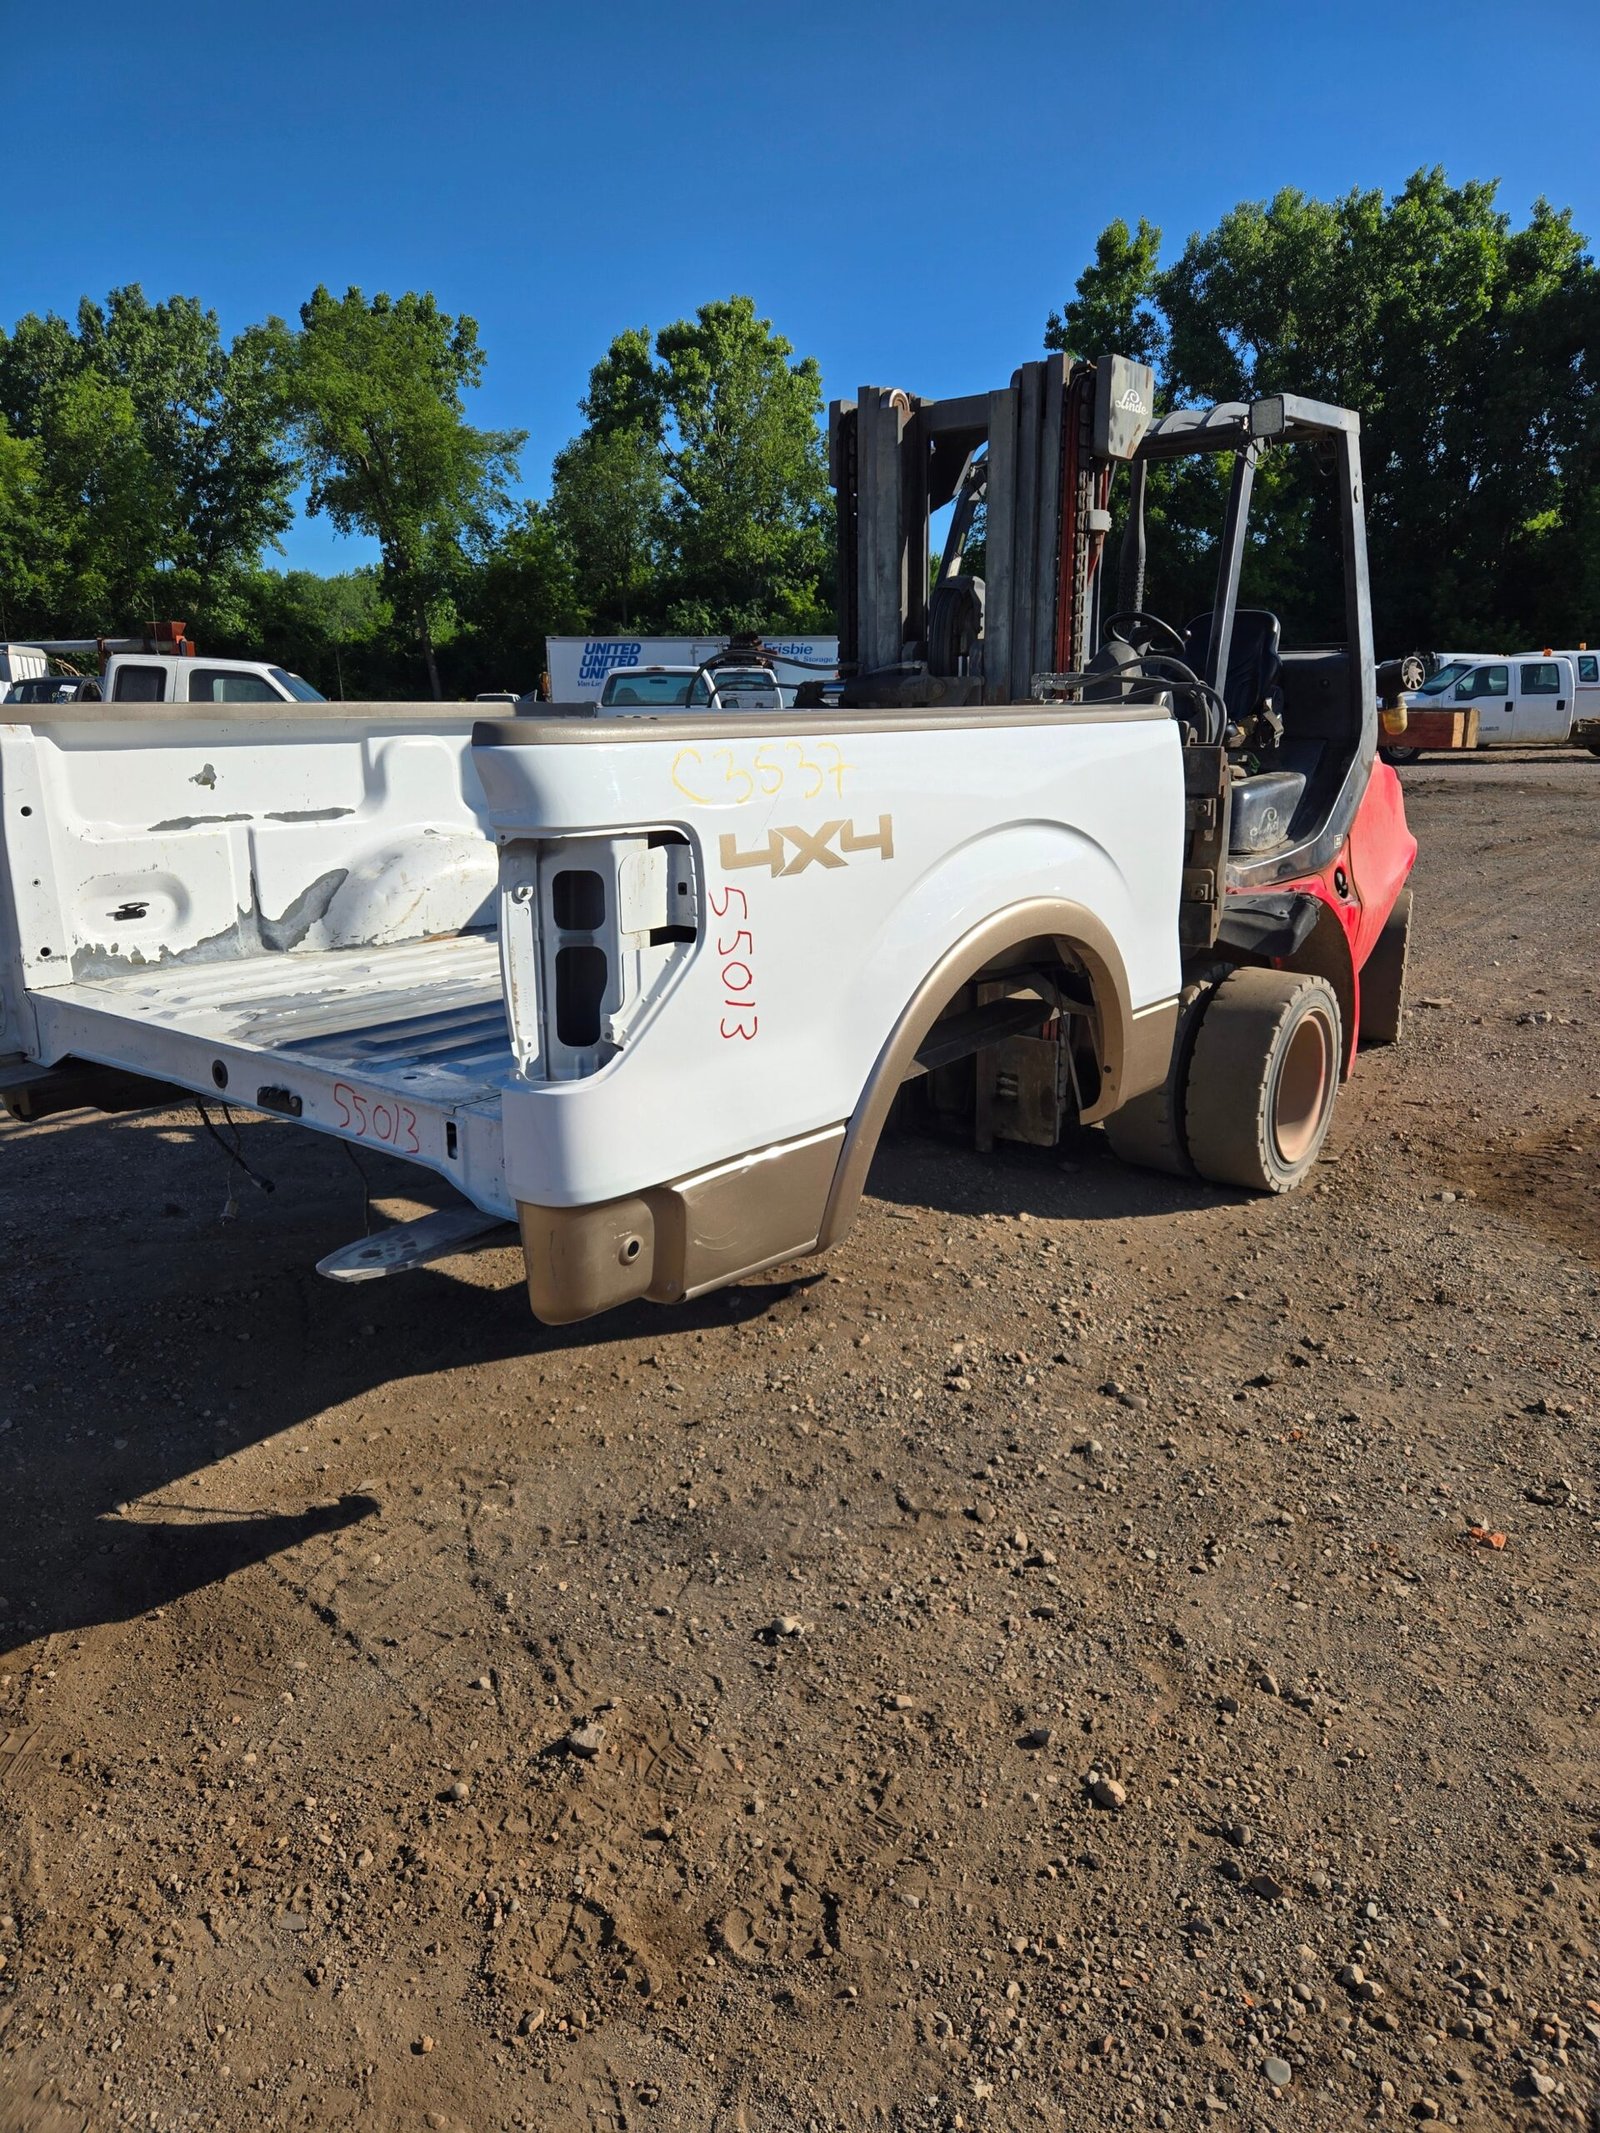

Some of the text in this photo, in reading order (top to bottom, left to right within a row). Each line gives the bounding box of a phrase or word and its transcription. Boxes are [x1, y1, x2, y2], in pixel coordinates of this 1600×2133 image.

[1115, 388, 1149, 416] Linde
[584, 642, 641, 655] UNITED
[581, 655, 639, 667] UNITED
[579, 667, 608, 679] UNI
[708, 886, 758, 1041] 55013
[333, 1082, 420, 1154] 55013
